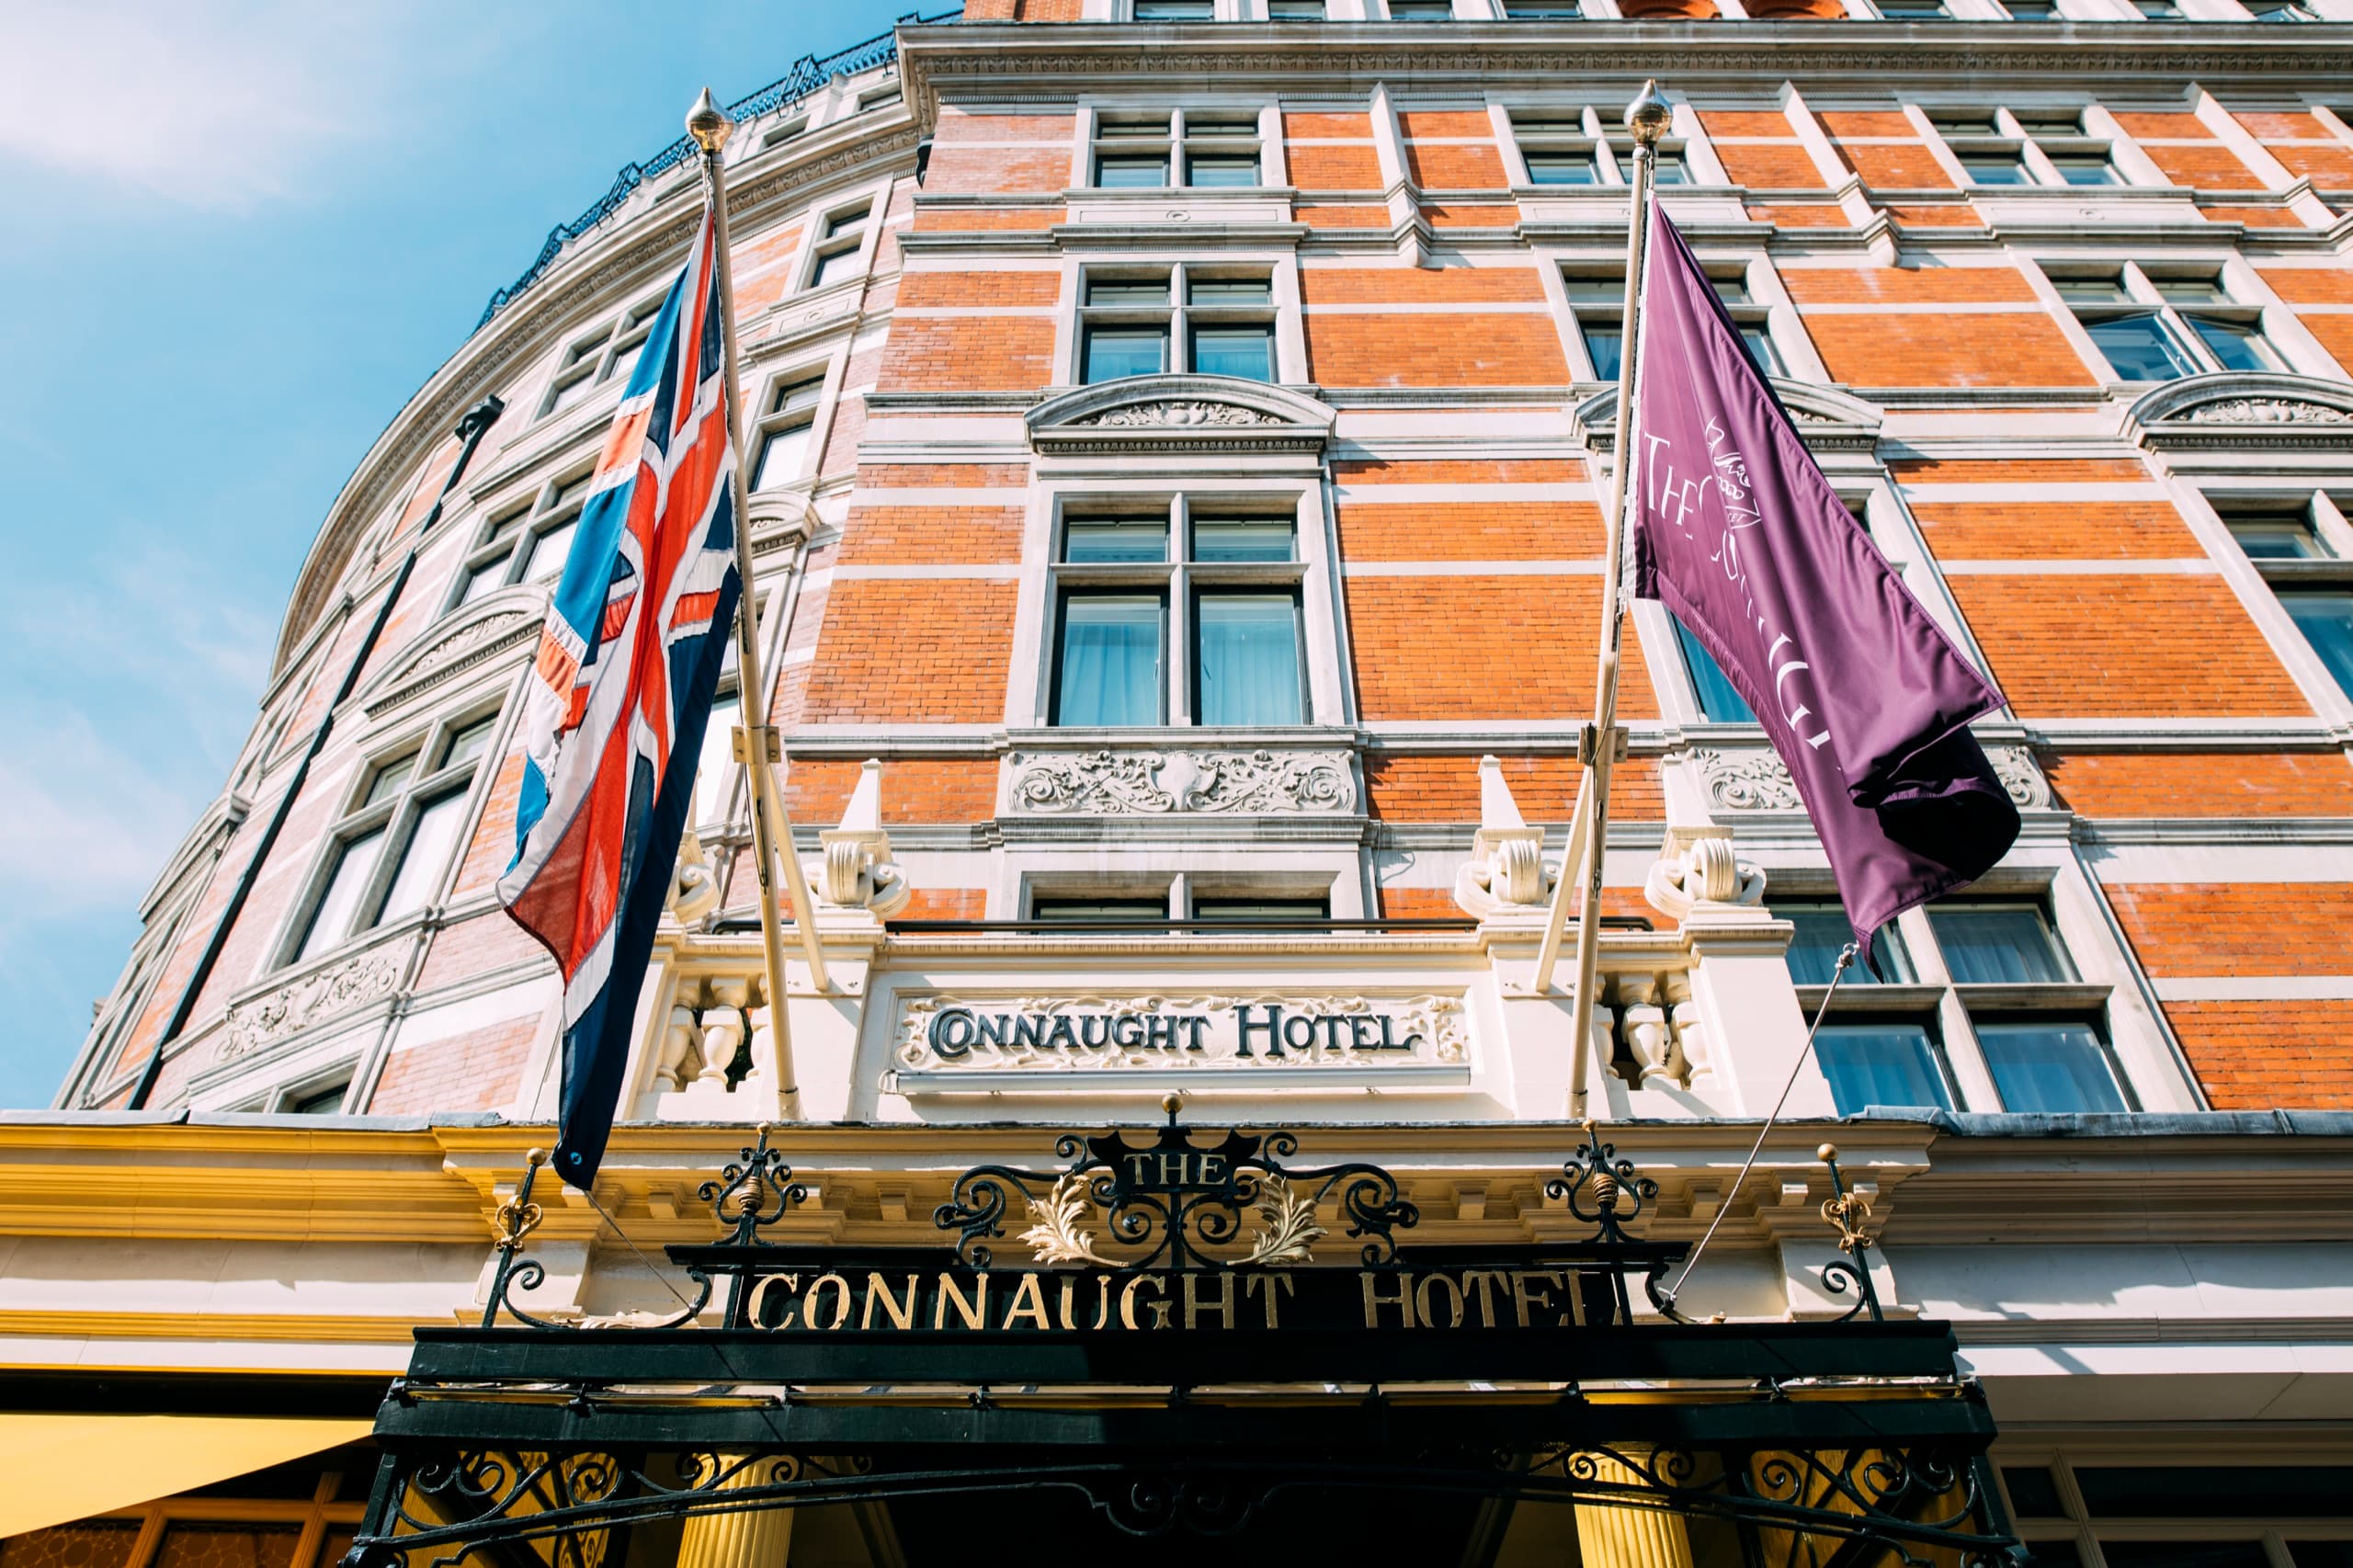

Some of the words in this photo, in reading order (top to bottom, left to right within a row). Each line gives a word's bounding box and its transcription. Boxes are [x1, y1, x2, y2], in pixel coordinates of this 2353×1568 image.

[928, 1007, 1211, 1058] CONNAUGHT
[1233, 1005, 1423, 1057] HOTEL
[1123, 1153, 1227, 1185] THE
[748, 1272, 1294, 1330] CONNAUGHT
